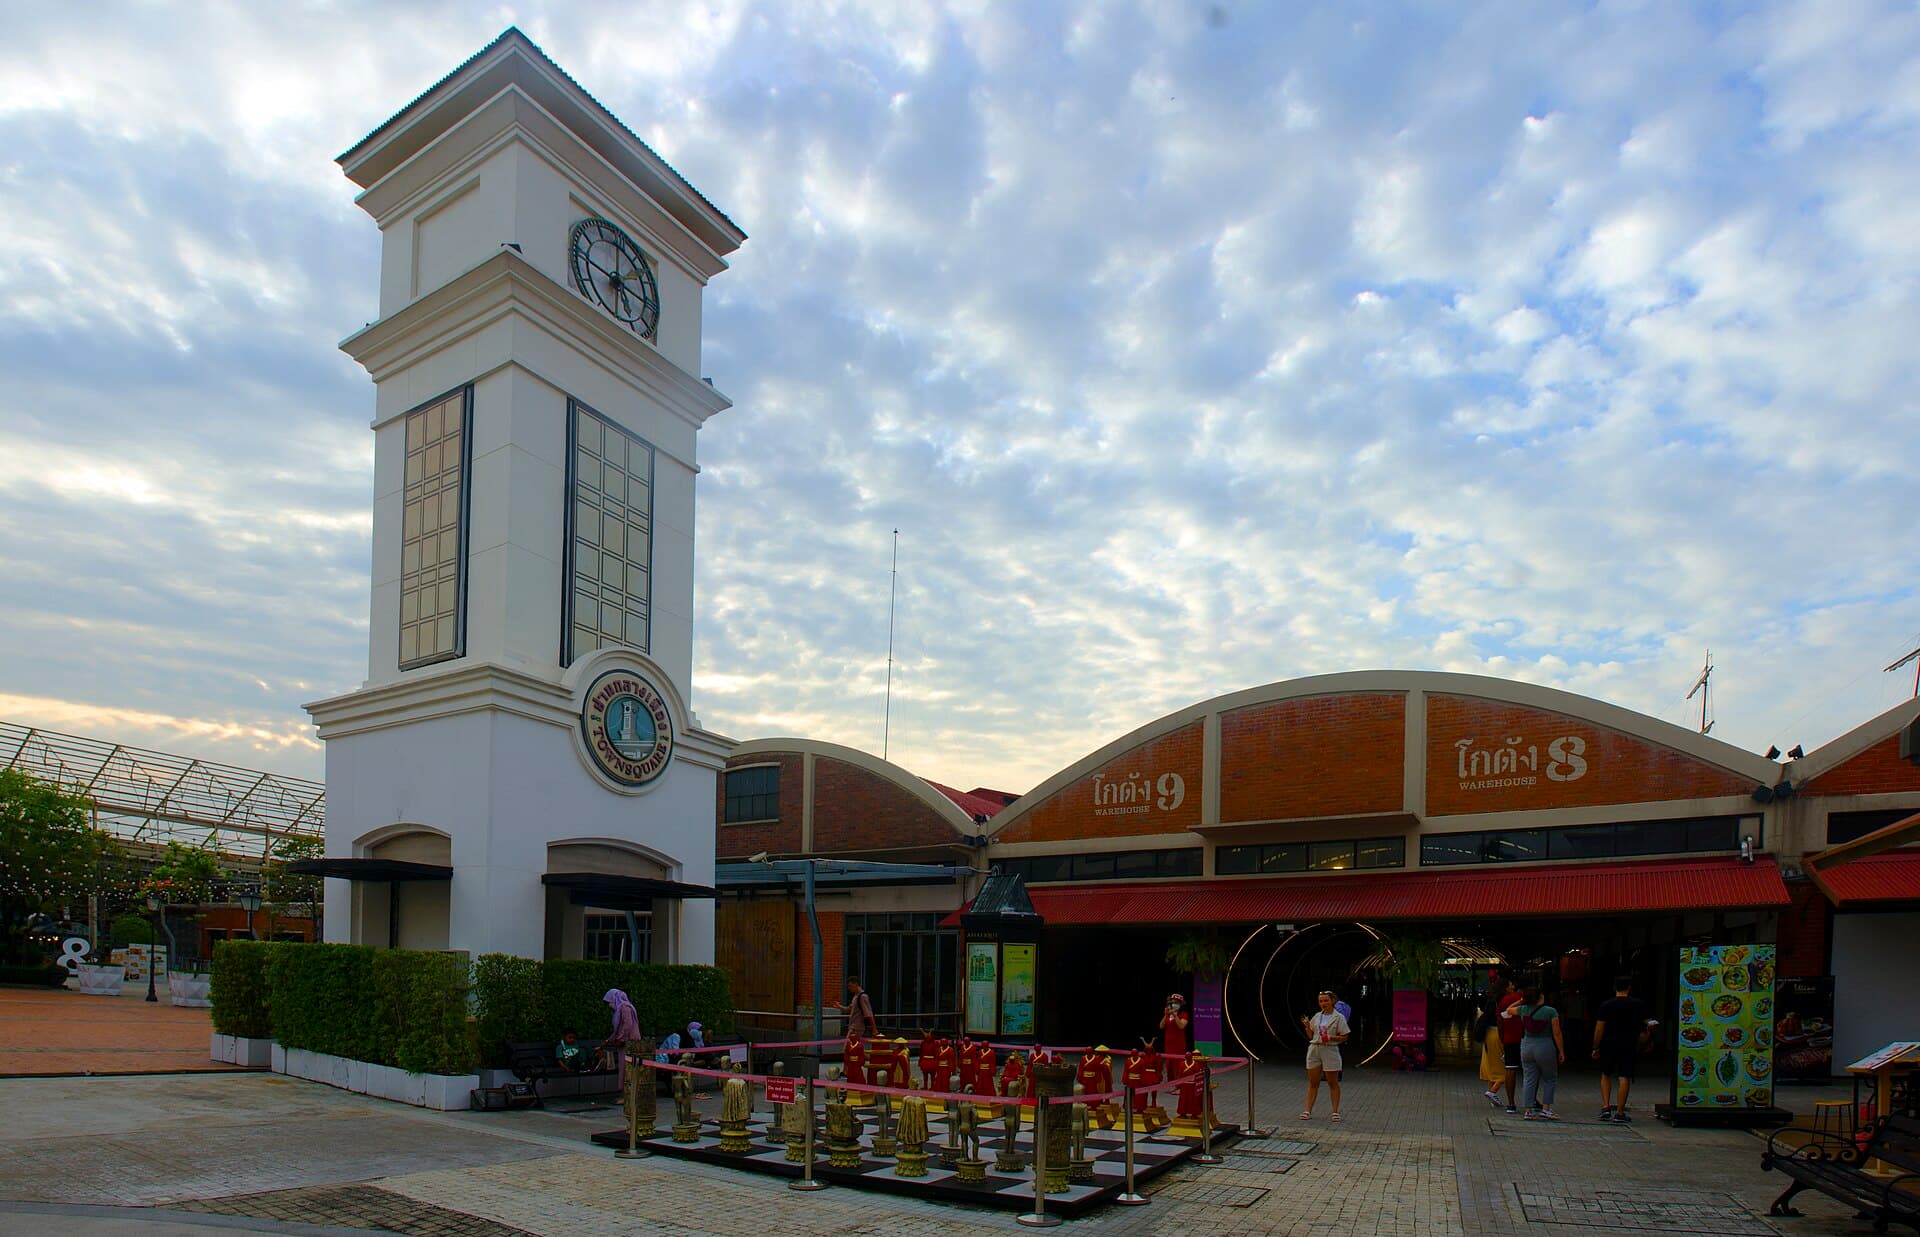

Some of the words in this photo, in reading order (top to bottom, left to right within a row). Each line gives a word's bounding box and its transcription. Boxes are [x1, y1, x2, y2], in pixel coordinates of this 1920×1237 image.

[1454, 736, 1538, 779] โกดัง
[1546, 736, 1588, 782] 8
[1092, 771, 1151, 806] โกดัง
[1157, 772, 1185, 811] 9
[1459, 776, 1537, 791] WAREHOUSE
[1095, 804, 1151, 816] WAREHOUSE
